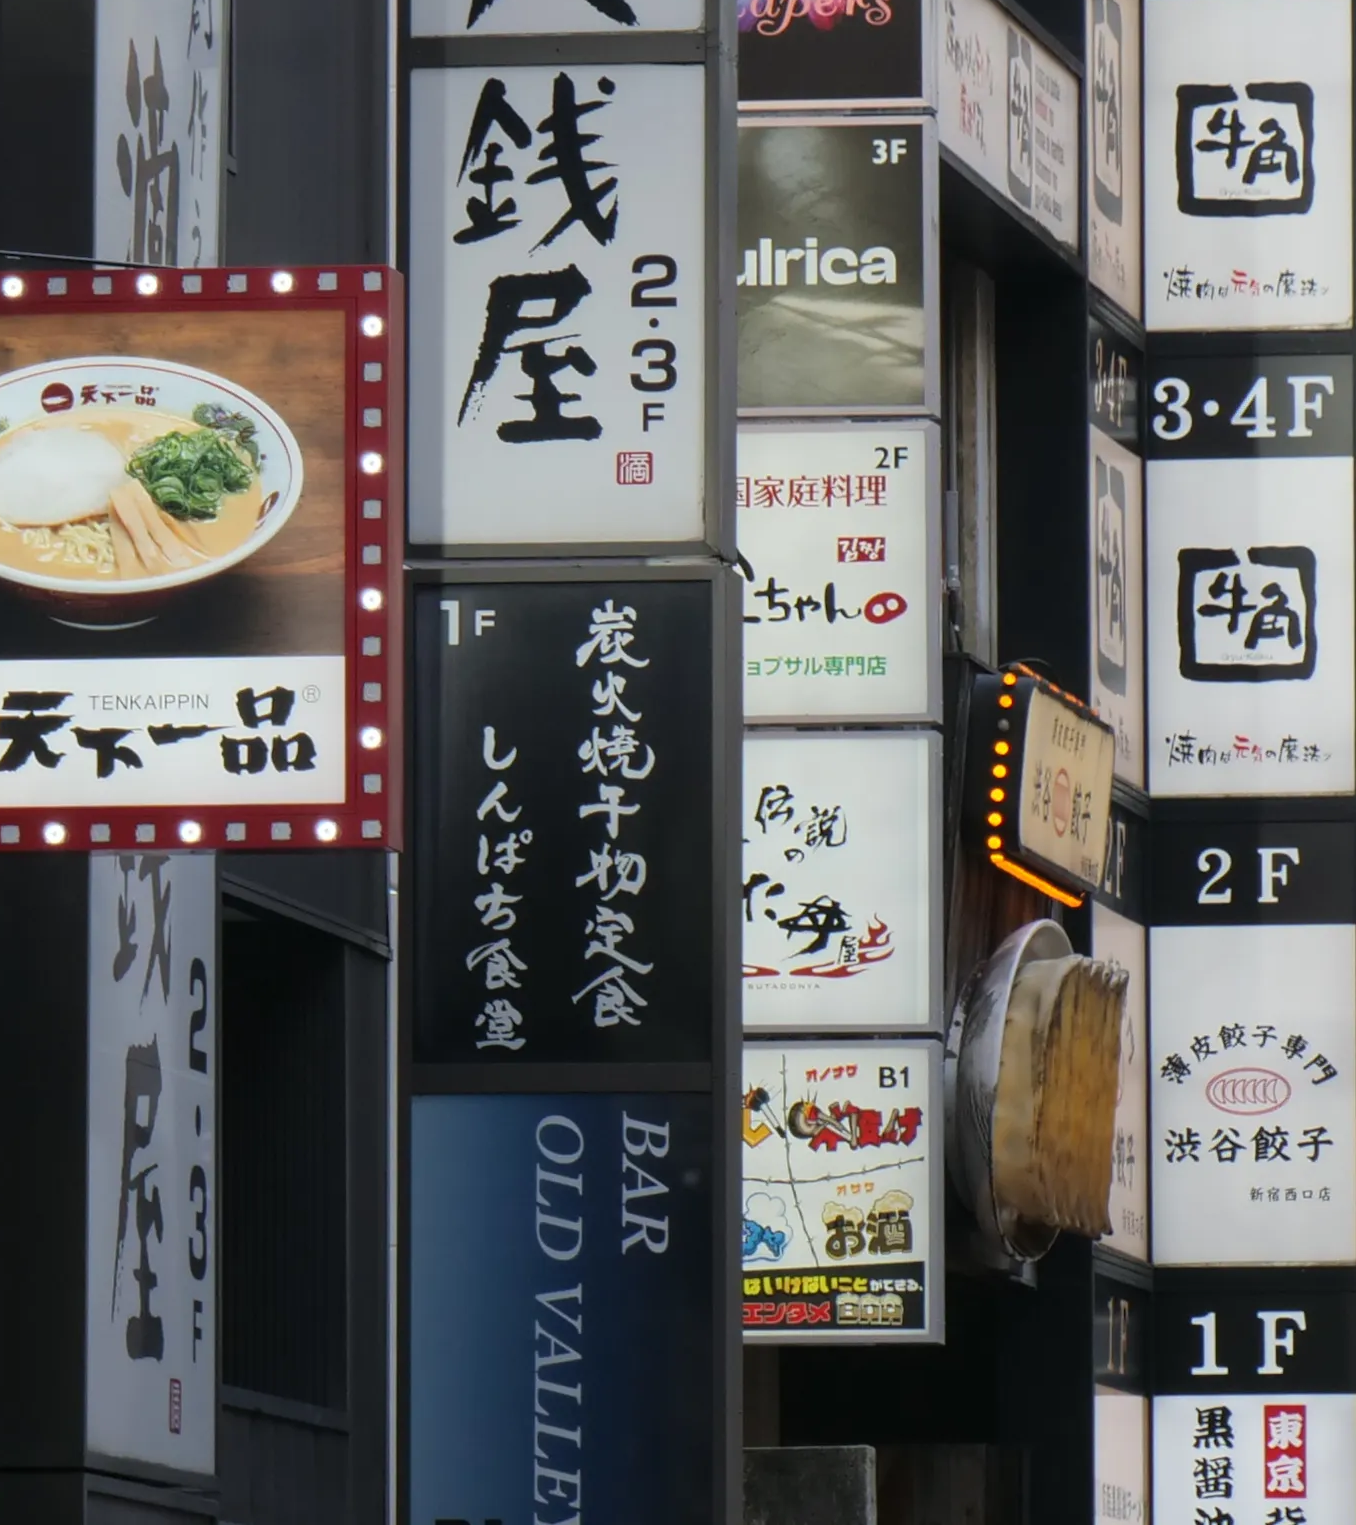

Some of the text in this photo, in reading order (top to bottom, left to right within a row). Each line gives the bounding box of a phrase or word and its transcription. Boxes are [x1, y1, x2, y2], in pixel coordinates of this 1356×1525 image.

[872, 139, 907, 164] 3F
[1196, 108, 1300, 185] 牛角
[453, 71, 620, 444] 銭屋
[81, 384, 157, 407] 天下一品
[875, 447, 909, 470] 2F
[440, 600, 495, 645] 1F
[1197, 571, 1302, 649] 牛角
[746, 656, 887, 676] ョプサル専門店
[88, 694, 209, 711] TENKAIPPIN
[572, 600, 654, 1027] 炭火焼干物定食
[466, 726, 533, 1050] しんぱち食堂
[1198, 847, 1301, 905] 2F
[879, 1066, 910, 1088] B1
[1161, 1022, 1339, 1087] 薄皮餃子専門
[1164, 1126, 1334, 1164] 渋谷餃子
[534, 1115, 584, 1262] OLD
[622, 1110, 669, 1256] BAR
[1250, 1186, 1332, 1202] 新宿西口店
[1190, 1311, 1307, 1376] 1F
